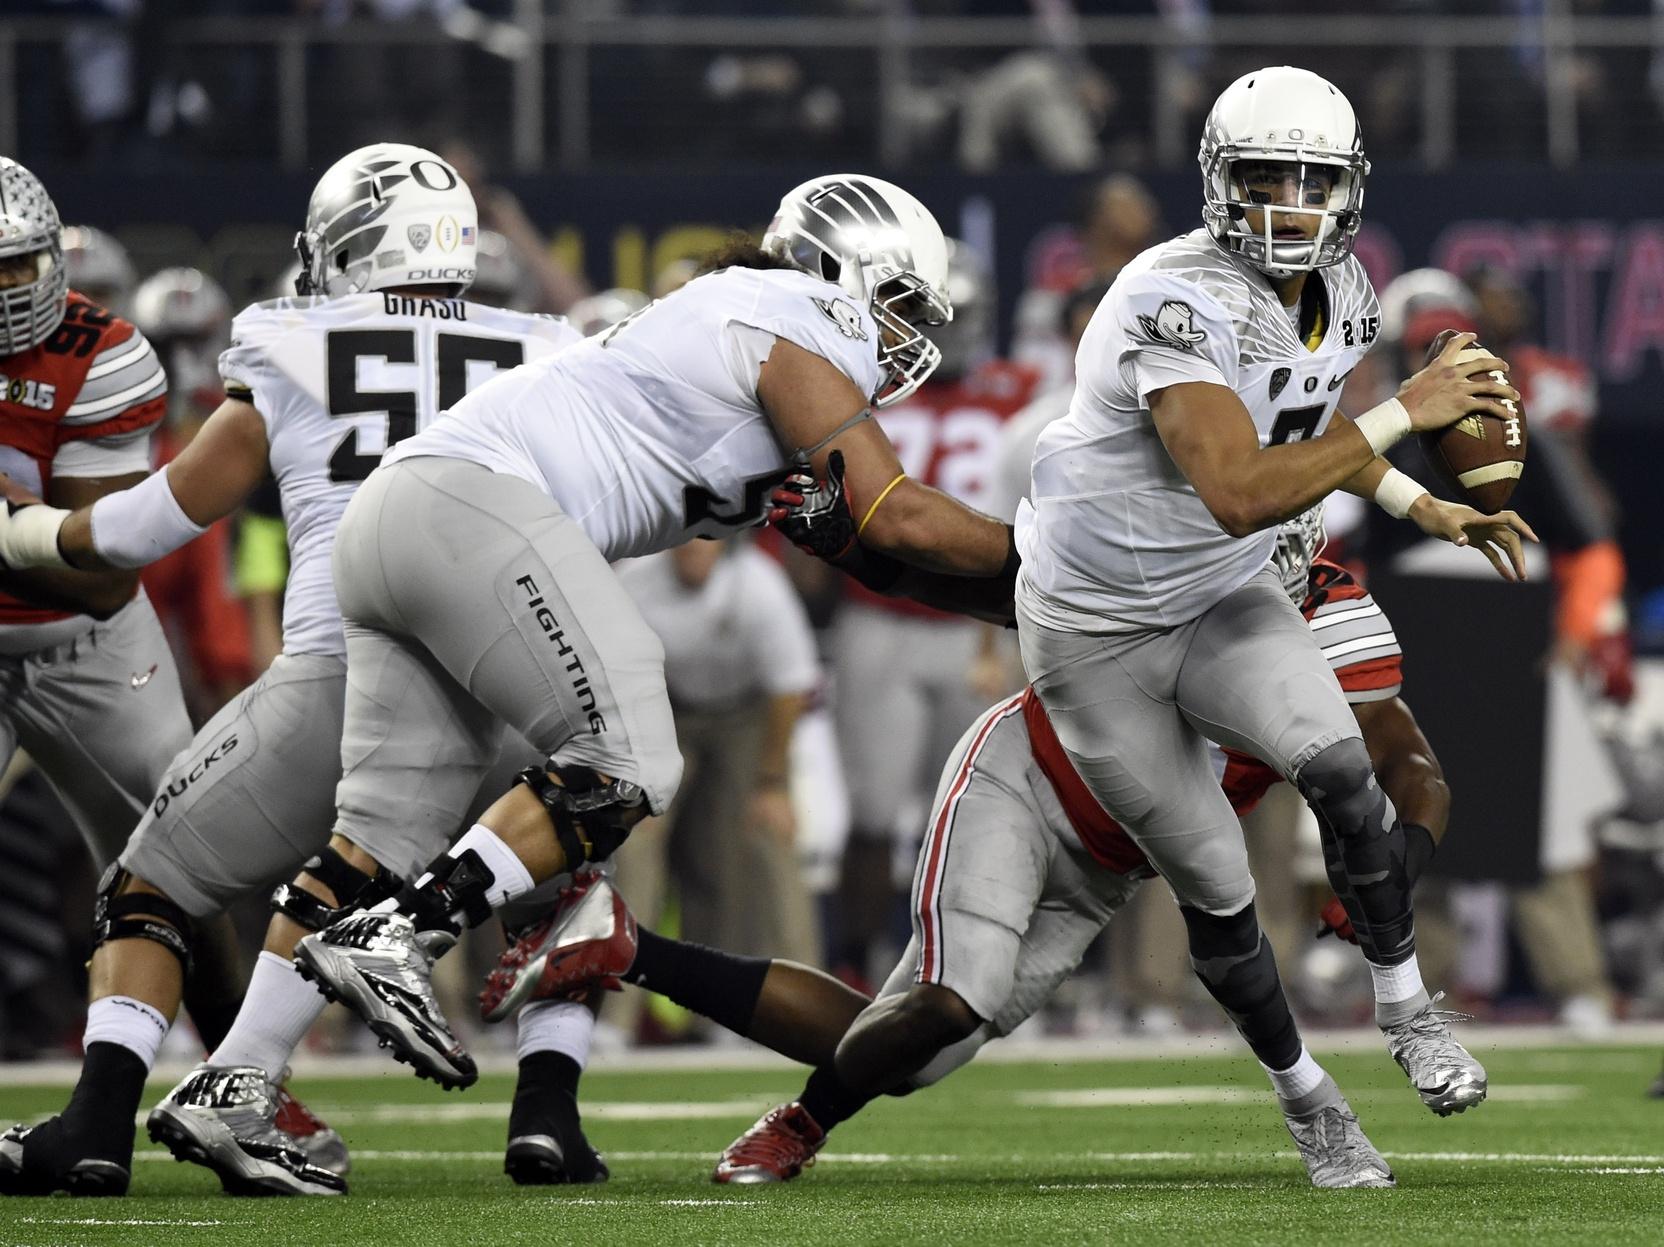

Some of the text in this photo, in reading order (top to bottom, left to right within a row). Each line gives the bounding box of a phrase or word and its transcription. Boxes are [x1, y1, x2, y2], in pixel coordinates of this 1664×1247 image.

[410, 160, 457, 191] O
[407, 268, 476, 280] DUCKS
[516, 574, 607, 735] FIGHTING
[154, 733, 238, 818] DUCKS
